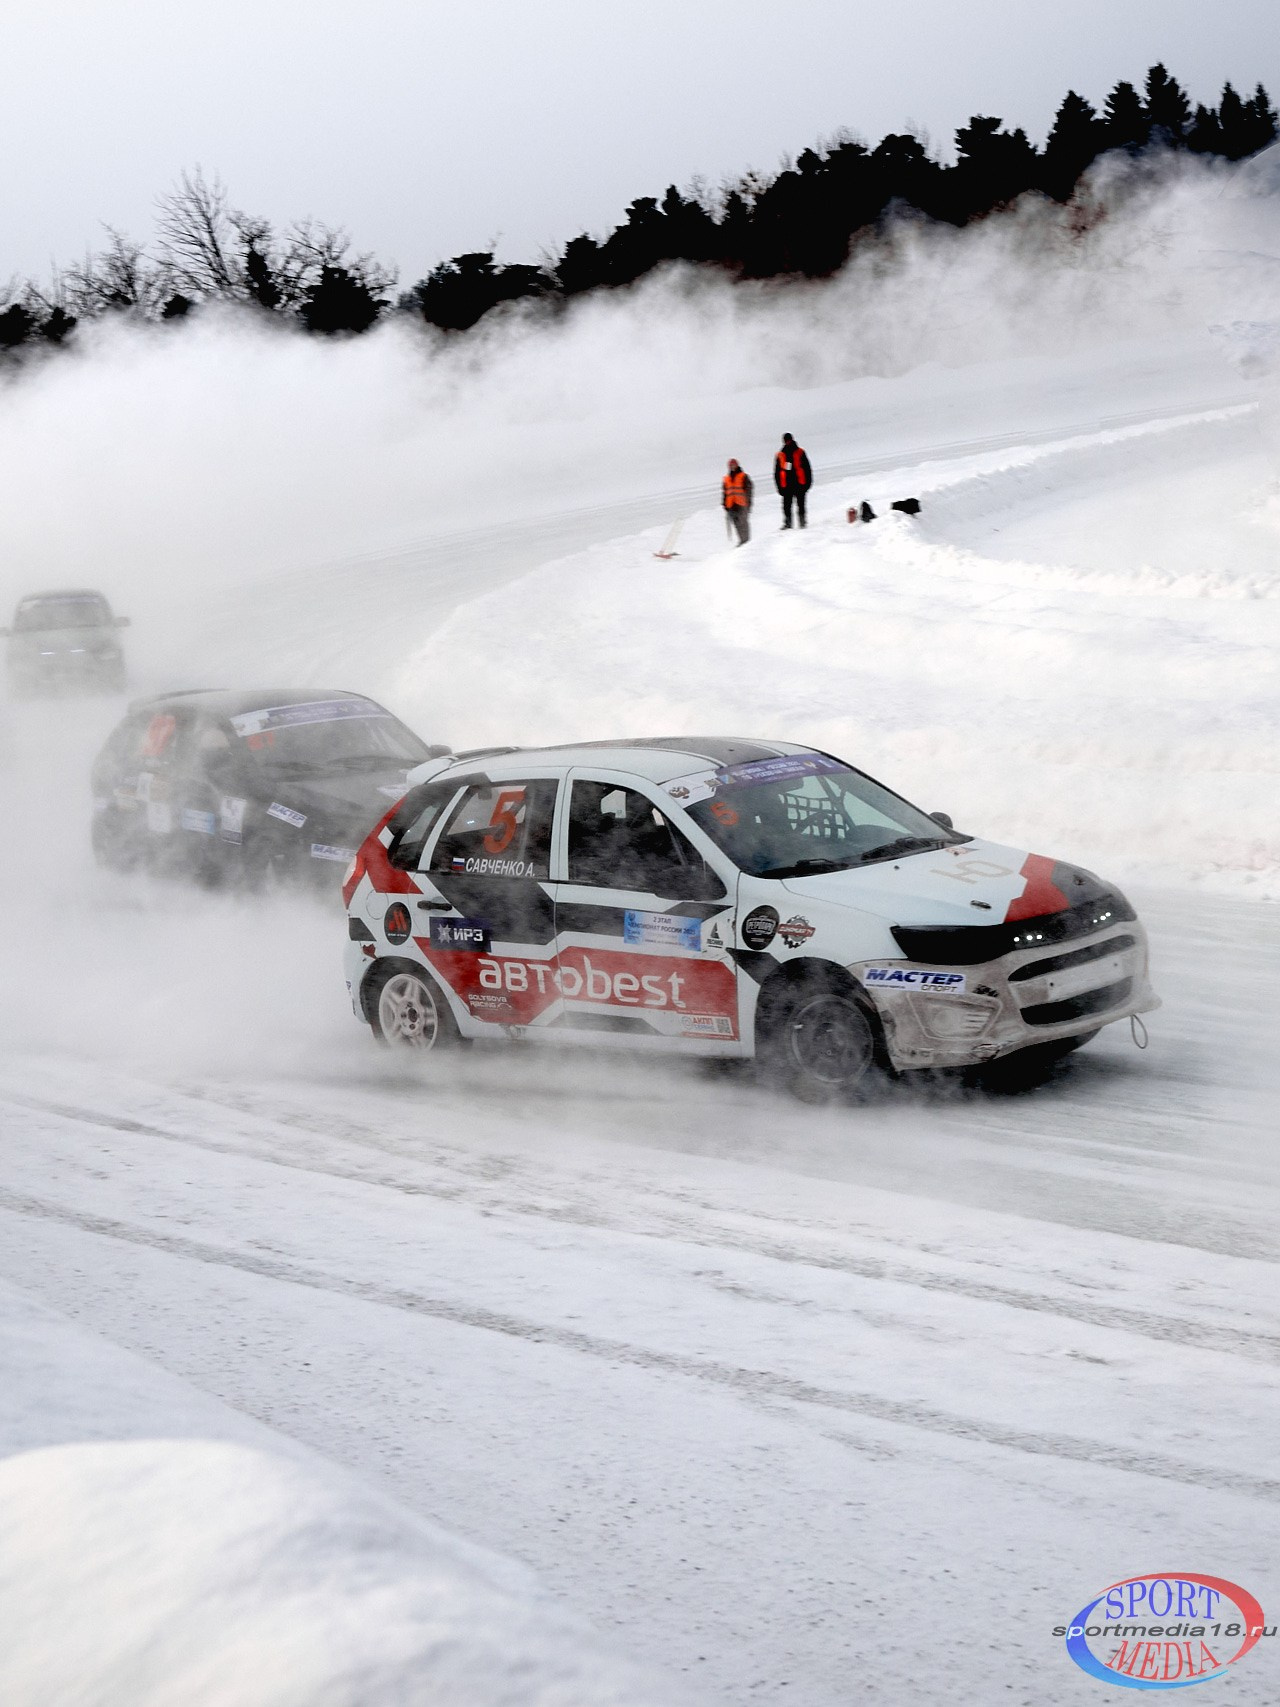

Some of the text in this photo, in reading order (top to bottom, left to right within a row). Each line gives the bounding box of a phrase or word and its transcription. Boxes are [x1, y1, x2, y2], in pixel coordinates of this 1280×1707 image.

[484, 790, 526, 854] 5
[710, 801, 739, 826] 5
[465, 857, 536, 877] САВЧЕНКО А.
[453, 927, 484, 942] ИРЗ
[661, 925, 683, 934] РОССИИ
[865, 968, 964, 985] МАСТЕР
[921, 984, 958, 993] СПОРТ
